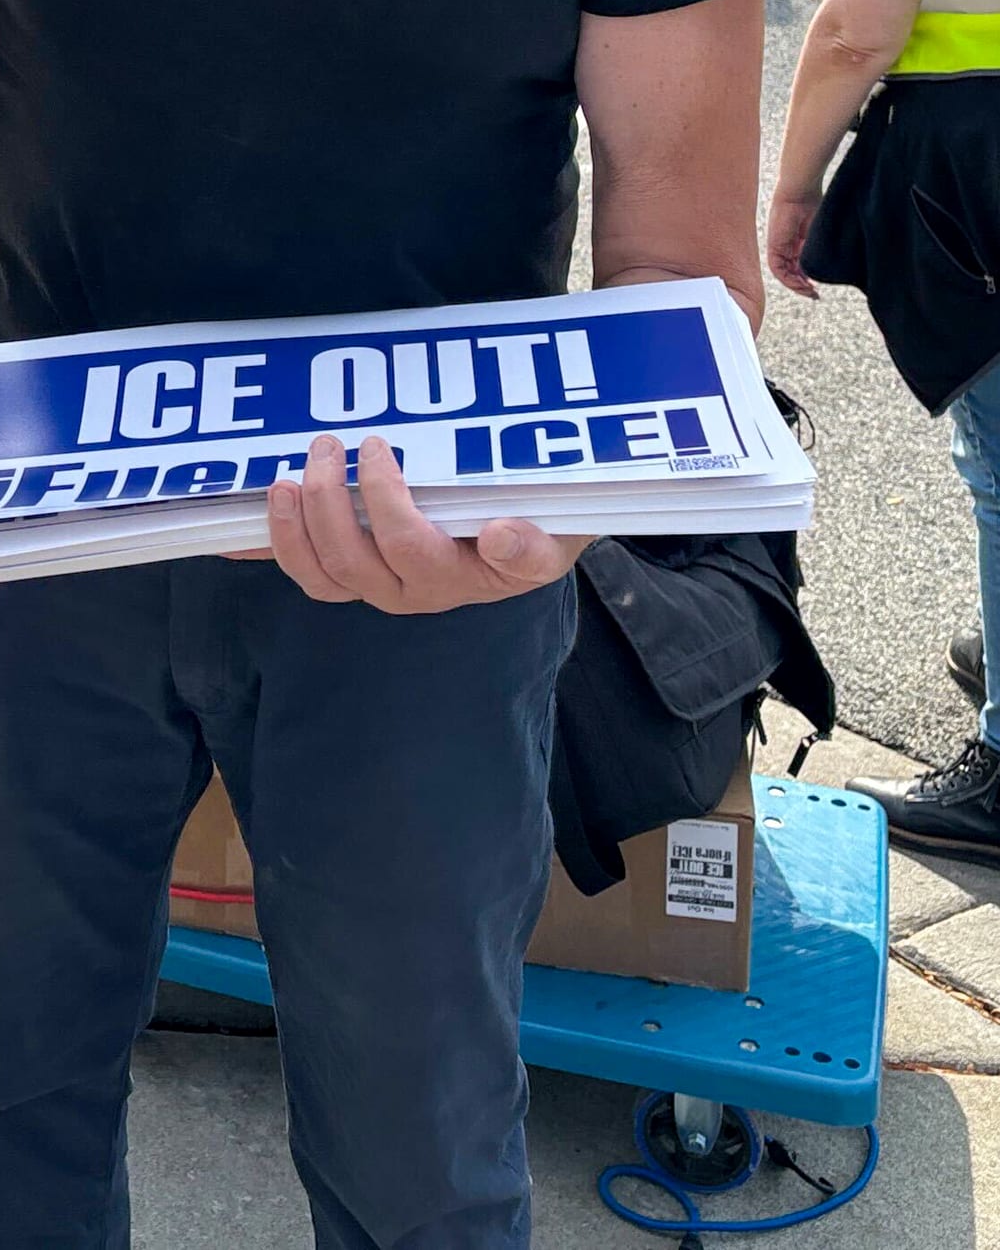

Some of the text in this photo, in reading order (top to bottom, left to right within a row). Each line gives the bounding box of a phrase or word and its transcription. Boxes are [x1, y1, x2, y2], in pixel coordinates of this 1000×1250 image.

[78, 330, 600, 446] ICE OUT!
[454, 407, 712, 476] ICE!
